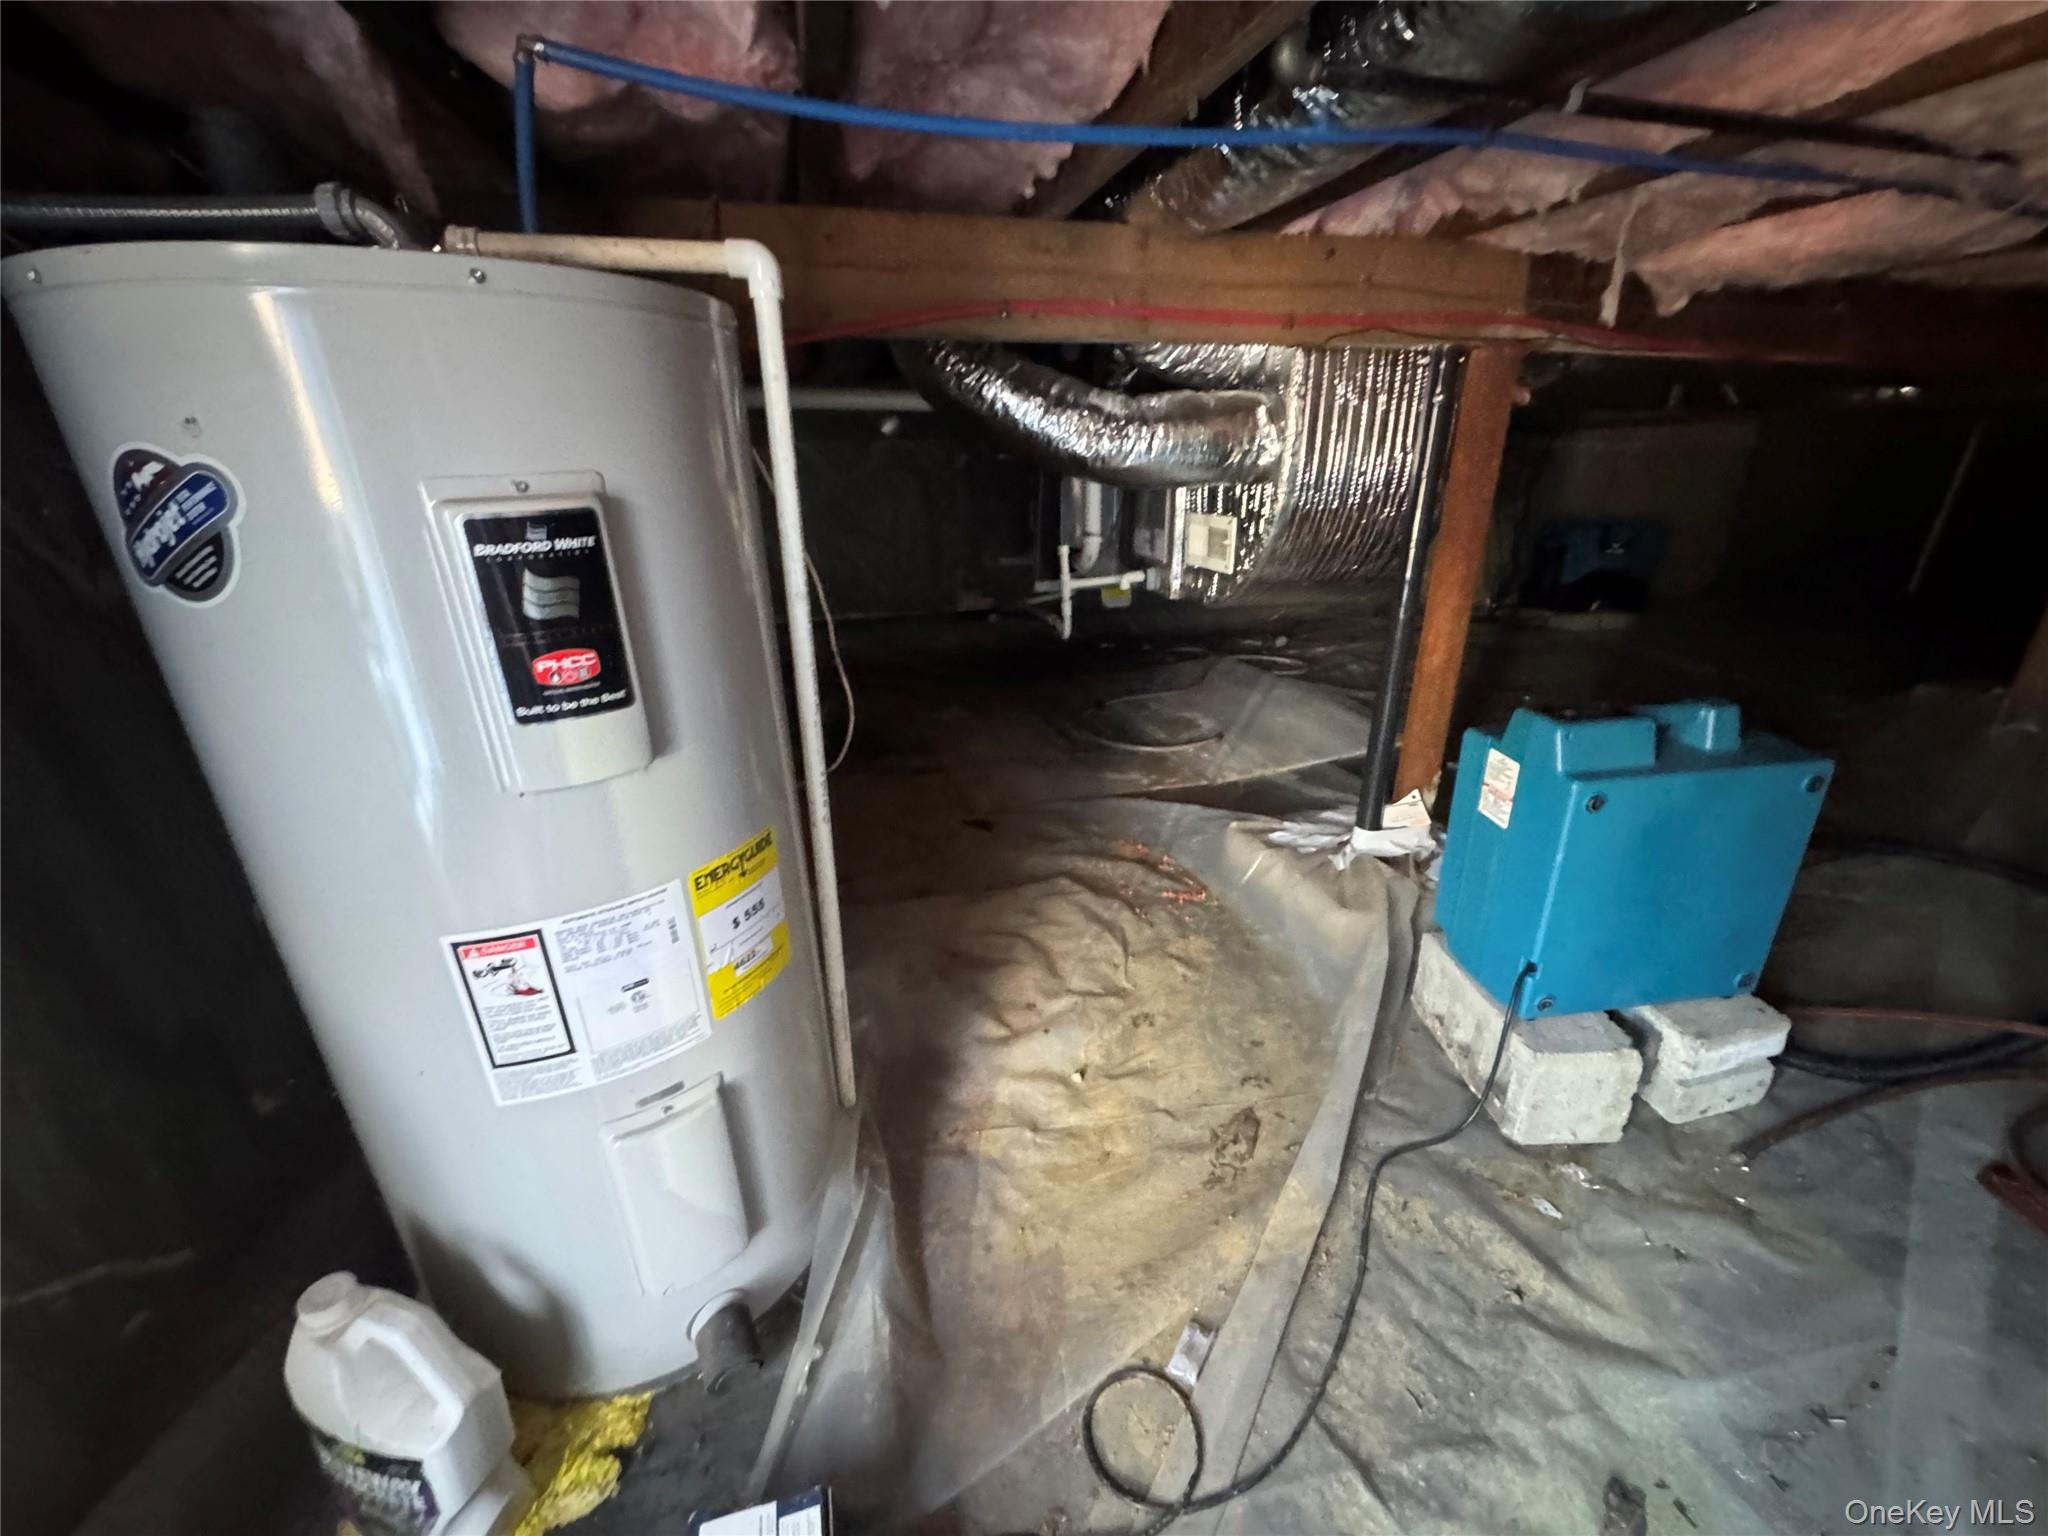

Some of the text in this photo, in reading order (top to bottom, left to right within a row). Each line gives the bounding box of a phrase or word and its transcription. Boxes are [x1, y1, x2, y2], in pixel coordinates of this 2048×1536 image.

[473, 535, 596, 558] BRADFORD WHITE
[536, 652, 597, 673] PHCC
